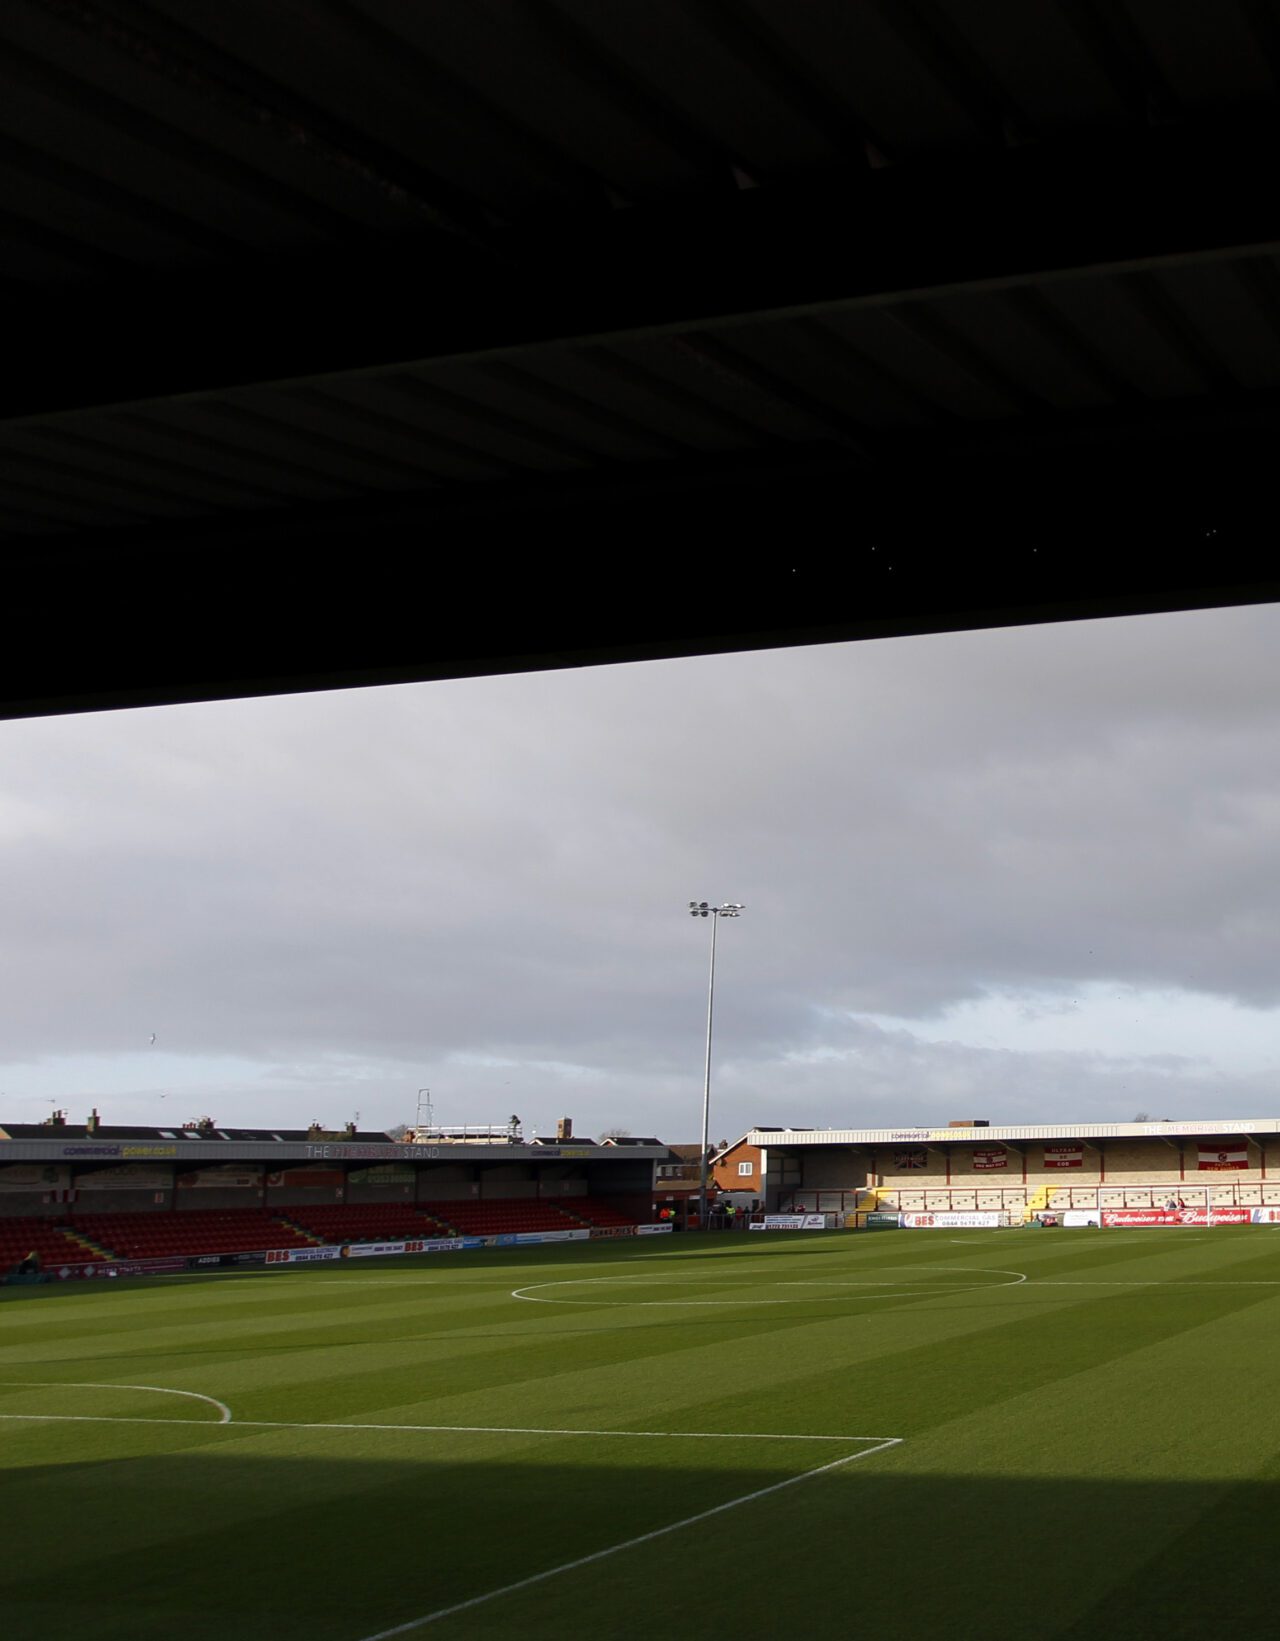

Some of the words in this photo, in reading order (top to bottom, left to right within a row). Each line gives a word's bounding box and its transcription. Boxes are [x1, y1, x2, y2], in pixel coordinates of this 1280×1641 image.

[1144, 1126, 1163, 1135] THE
[1168, 1124, 1218, 1134] MEMORIAL
[1223, 1122, 1255, 1132] STAND
[306, 1146, 329, 1158] THE
[404, 1146, 440, 1158] STAND
[915, 1216, 935, 1226] BES
[1103, 1213, 1156, 1224] Budweiser
[1179, 1211, 1248, 1223] Budweiser
[404, 1241, 424, 1252] BES
[268, 1251, 290, 1262] BES
